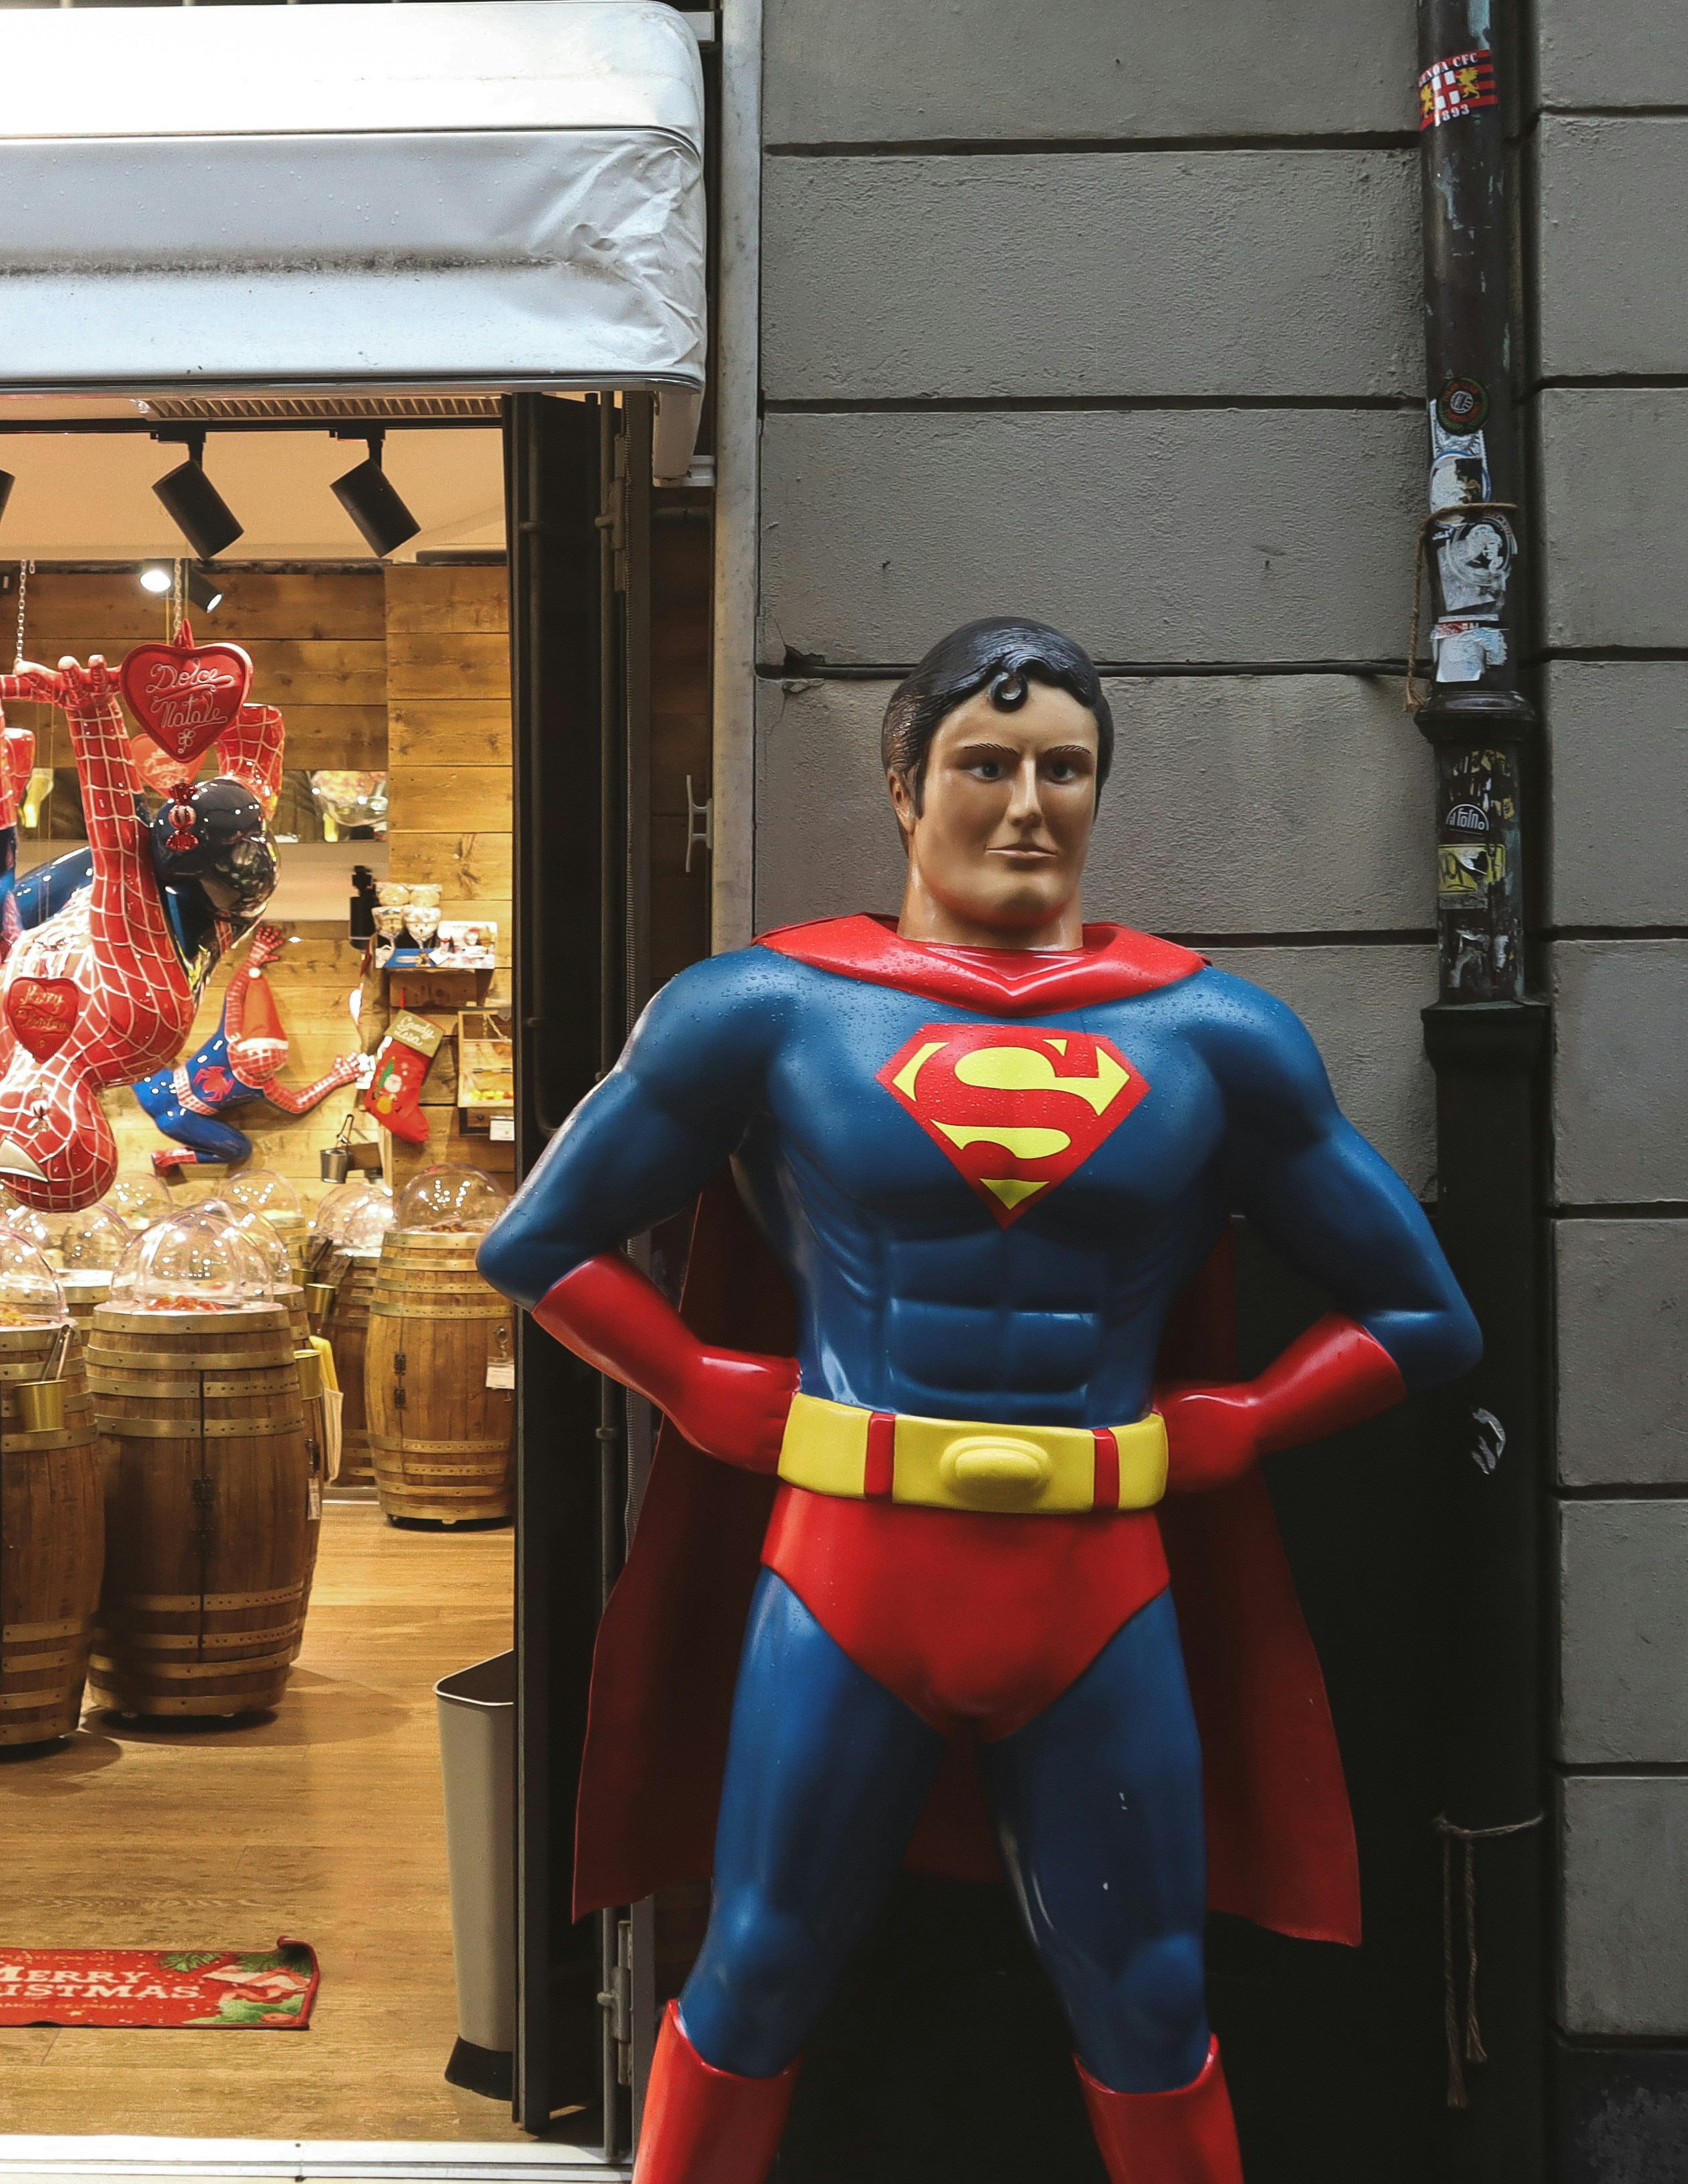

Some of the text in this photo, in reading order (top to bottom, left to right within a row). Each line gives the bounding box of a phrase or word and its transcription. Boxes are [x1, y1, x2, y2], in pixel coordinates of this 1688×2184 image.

[1452, 53, 1478, 67] CFC
[1434, 103, 1470, 127] 1893
[146, 657, 236, 694] Dolce
[150, 690, 228, 728] Natale
[396, 1015, 435, 1040] Candy
[0, 1984, 200, 1998] ISTMAS
